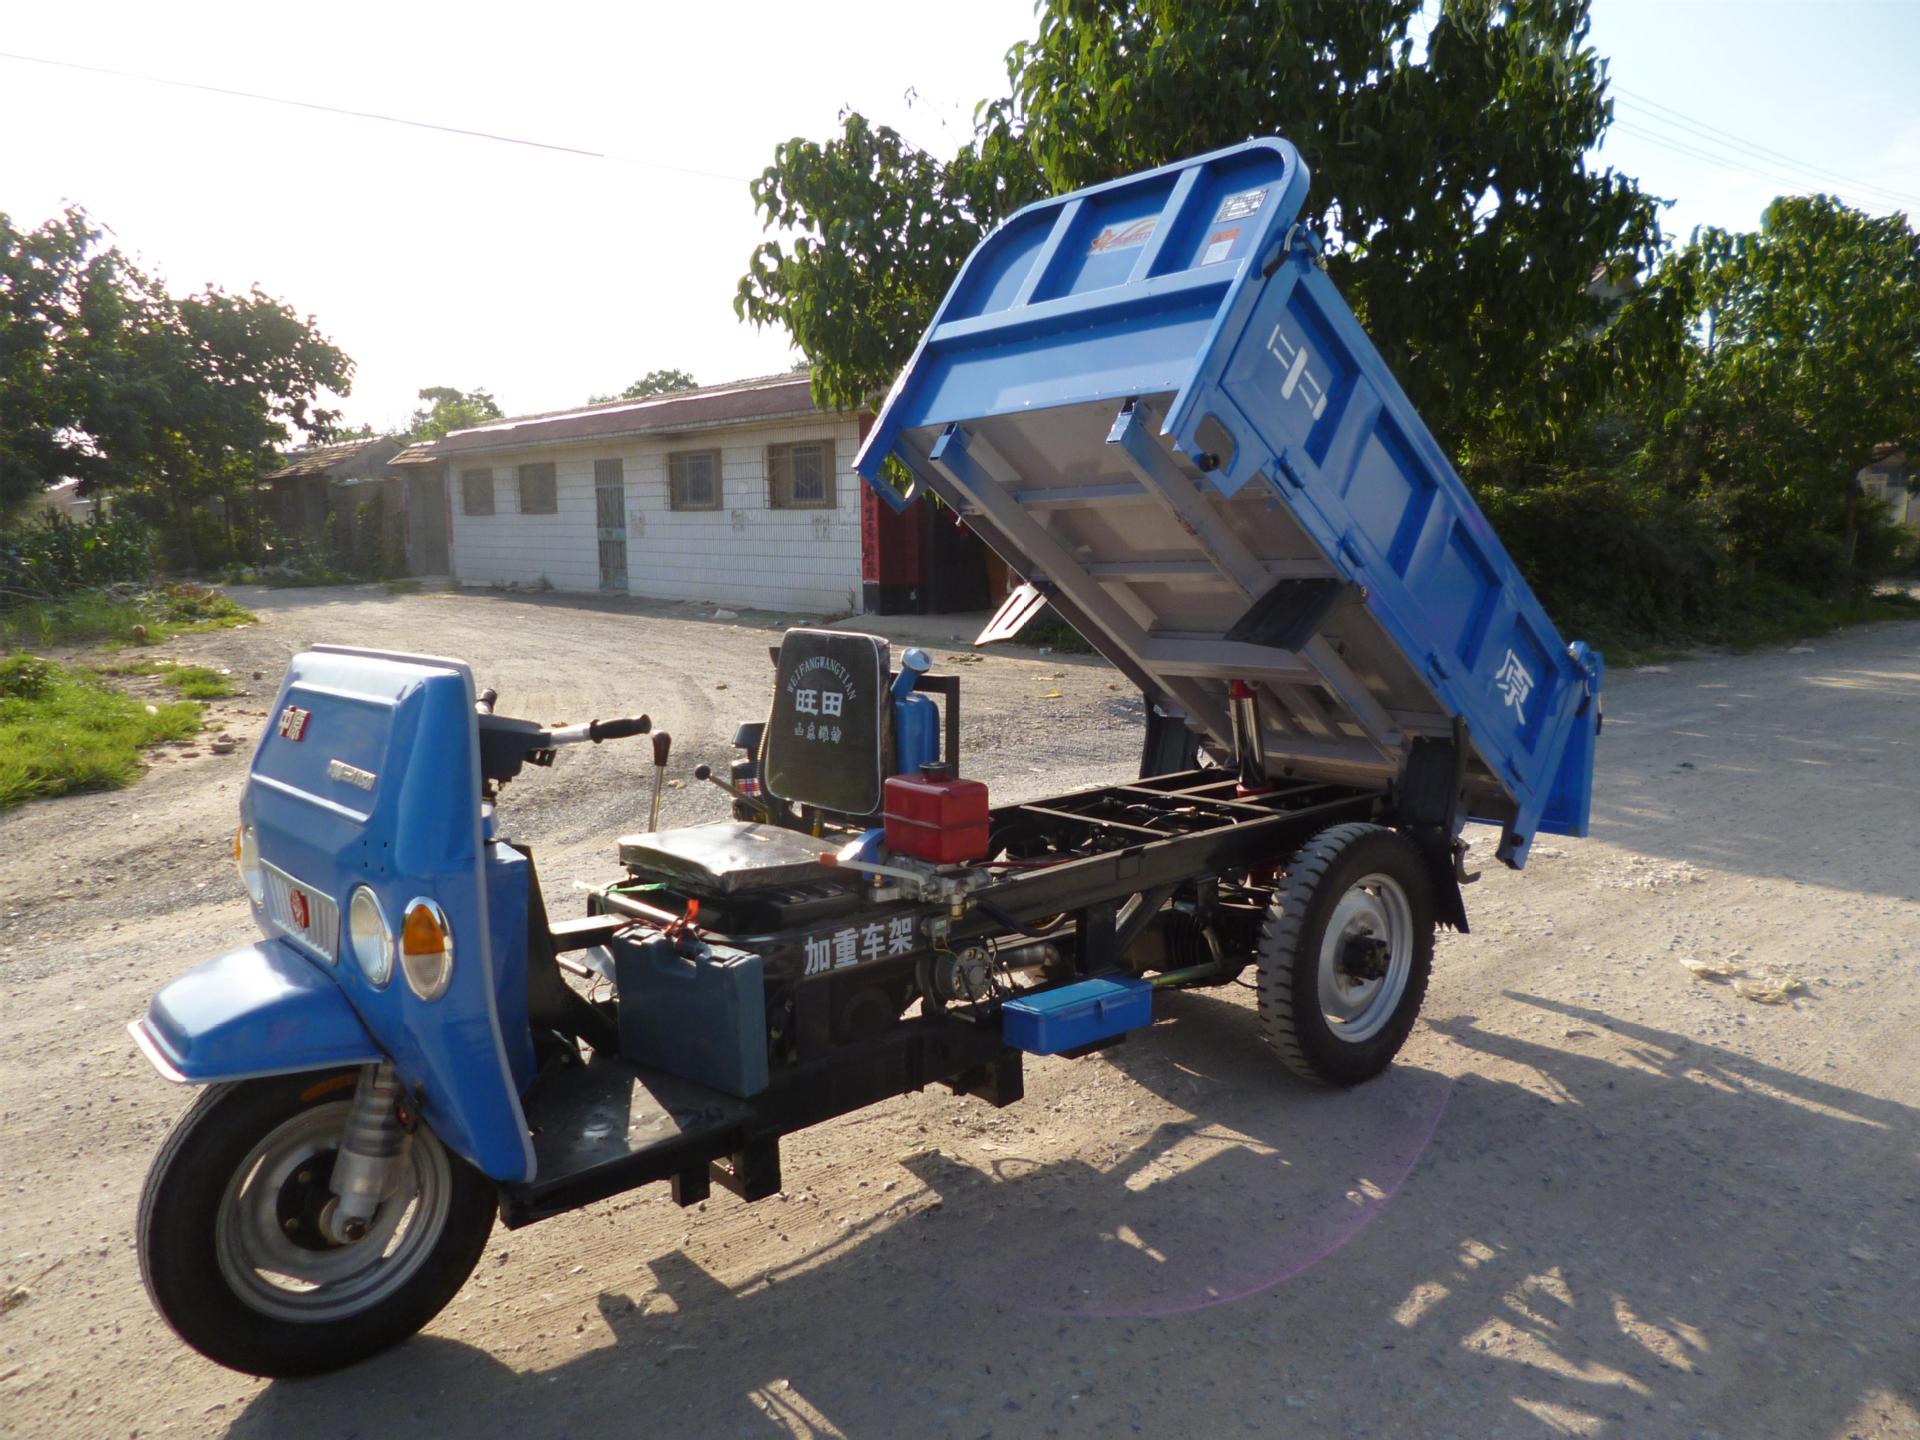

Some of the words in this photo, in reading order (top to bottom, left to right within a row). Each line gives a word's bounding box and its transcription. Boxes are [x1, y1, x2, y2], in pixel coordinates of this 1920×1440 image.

[795, 689, 843, 718] 旺田
[804, 917, 913, 976] 加重车架
